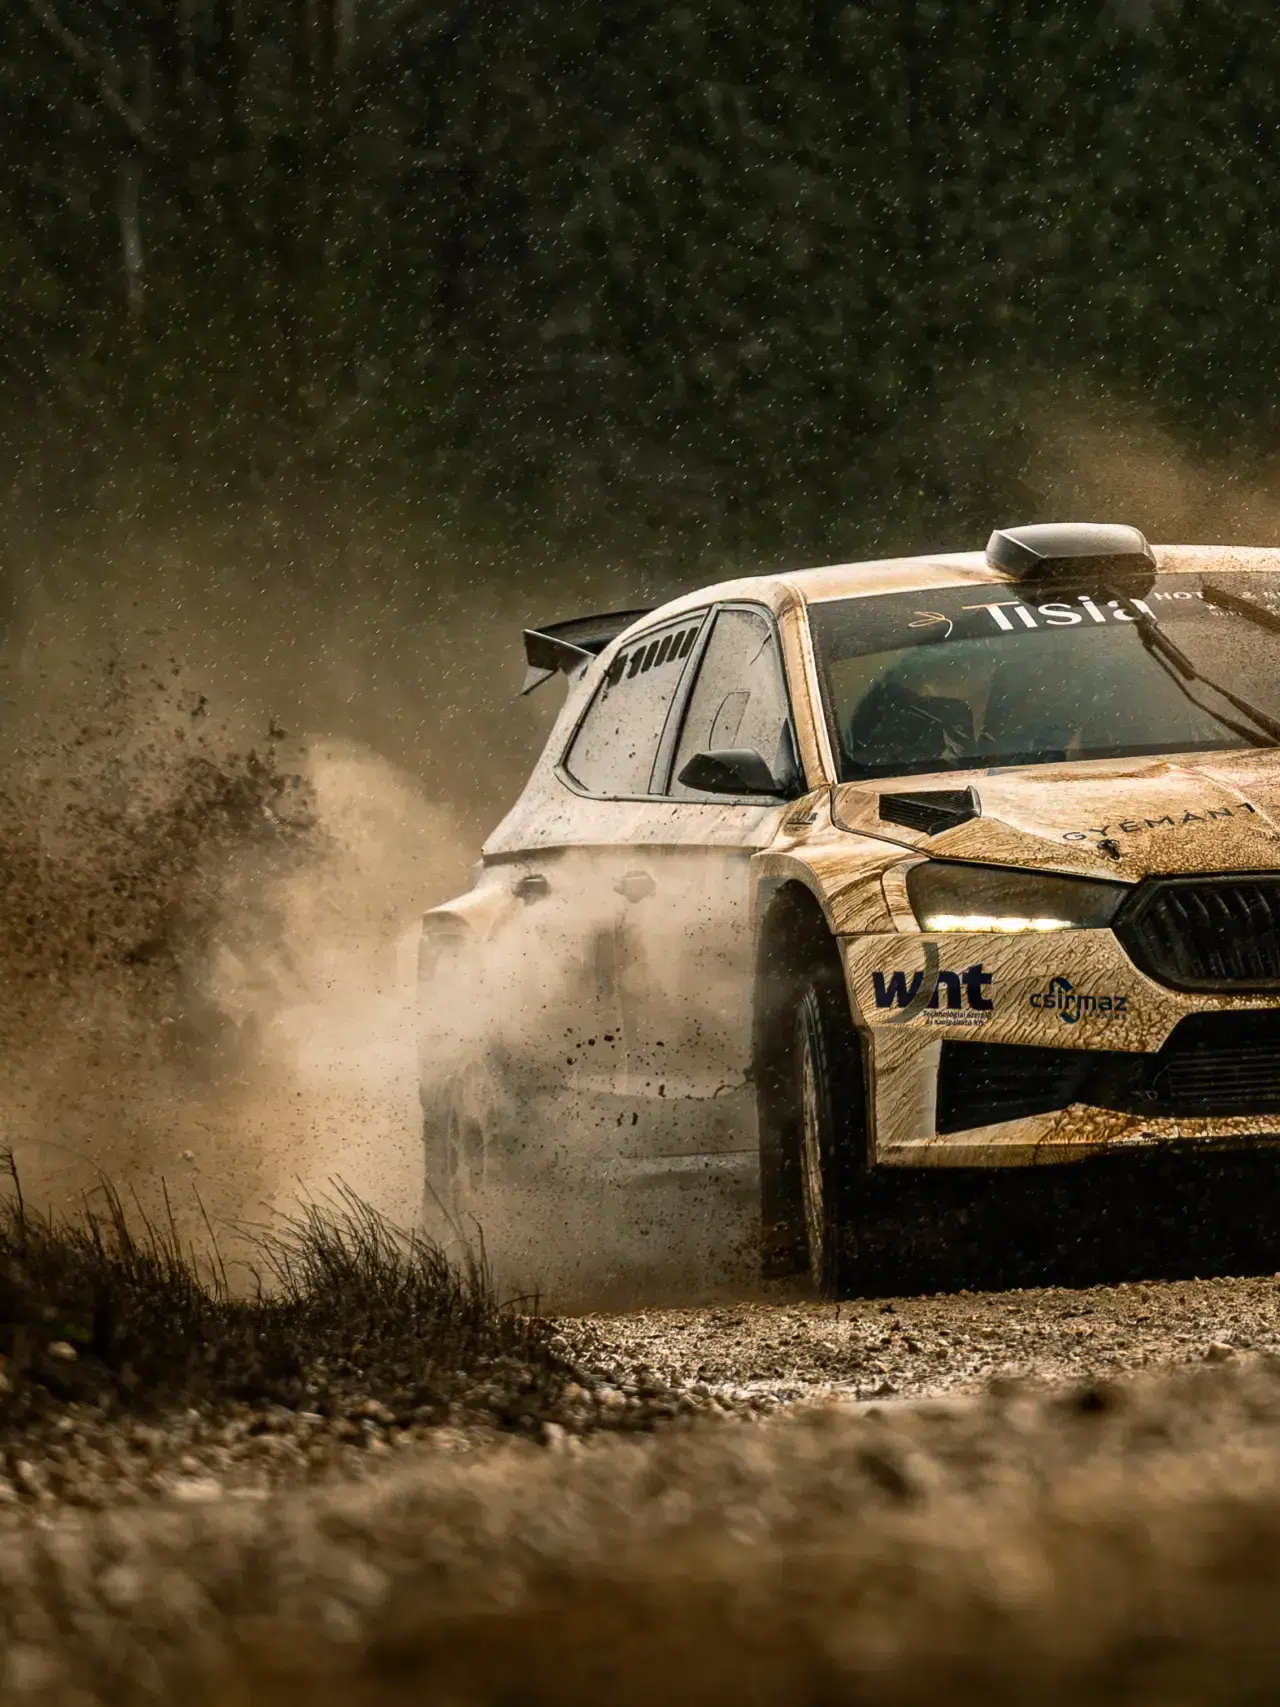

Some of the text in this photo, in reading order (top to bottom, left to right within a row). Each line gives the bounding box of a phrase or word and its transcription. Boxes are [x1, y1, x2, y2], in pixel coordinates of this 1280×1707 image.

[962, 595, 1157, 630] Tisia
[872, 963, 994, 1010] wnt
[1030, 987, 1128, 1013] csirmaz
